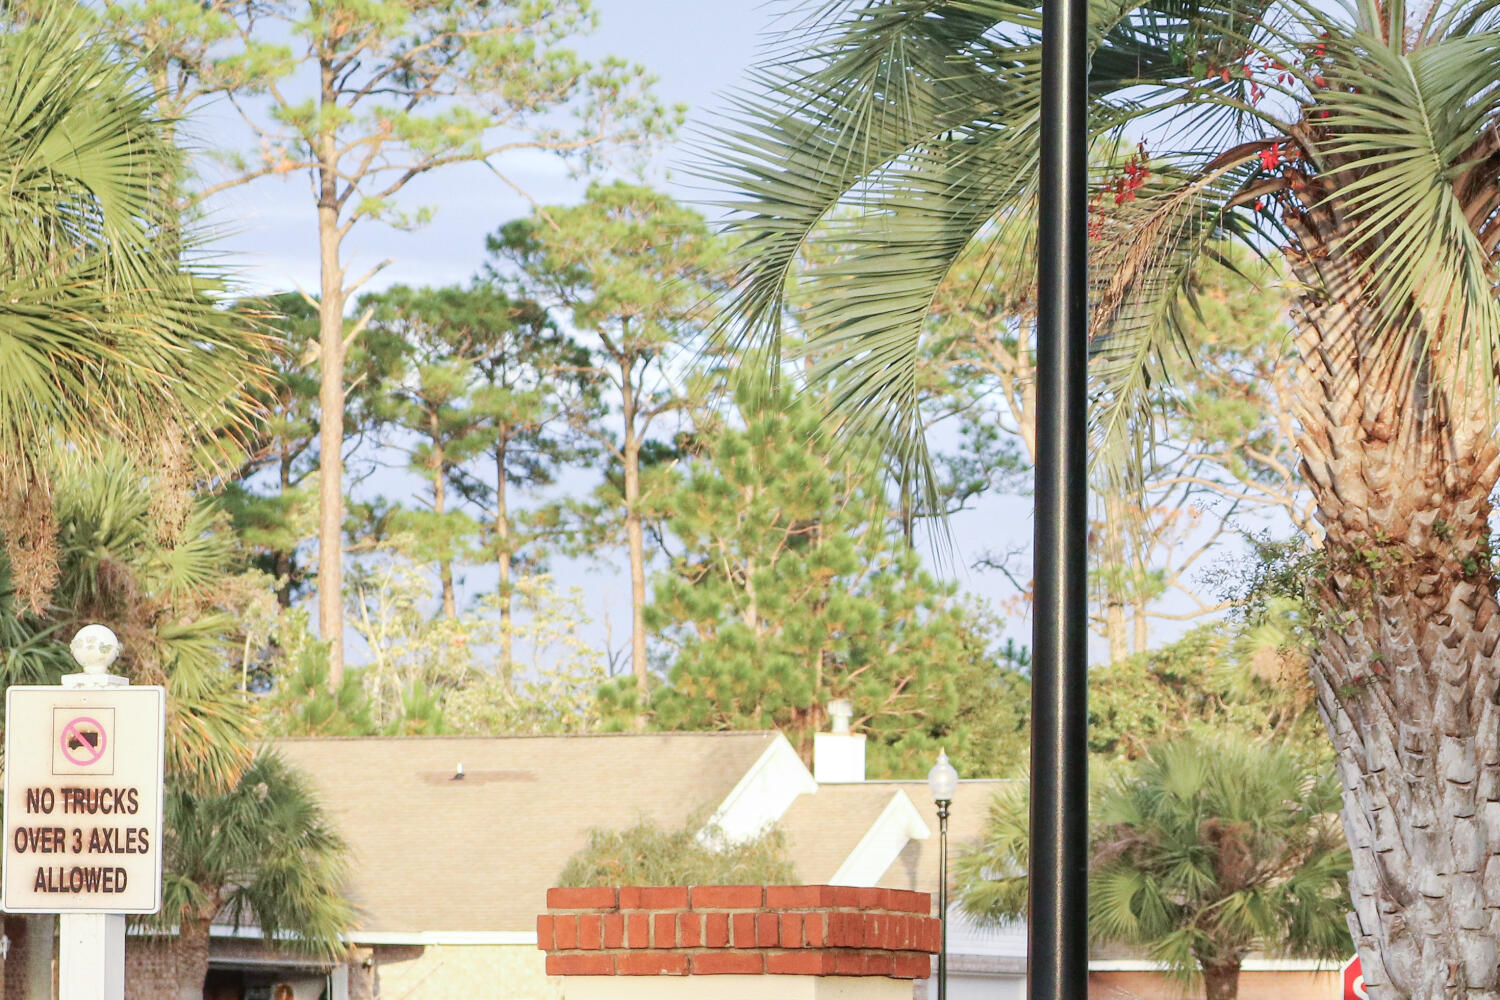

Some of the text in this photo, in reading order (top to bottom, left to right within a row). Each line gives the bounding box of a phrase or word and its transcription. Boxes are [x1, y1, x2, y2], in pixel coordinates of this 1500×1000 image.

[26, 787, 139, 815] NO TRUCKS
[14, 826, 150, 854] OVER 3 AXLES
[33, 866, 128, 893] ALLOWED
